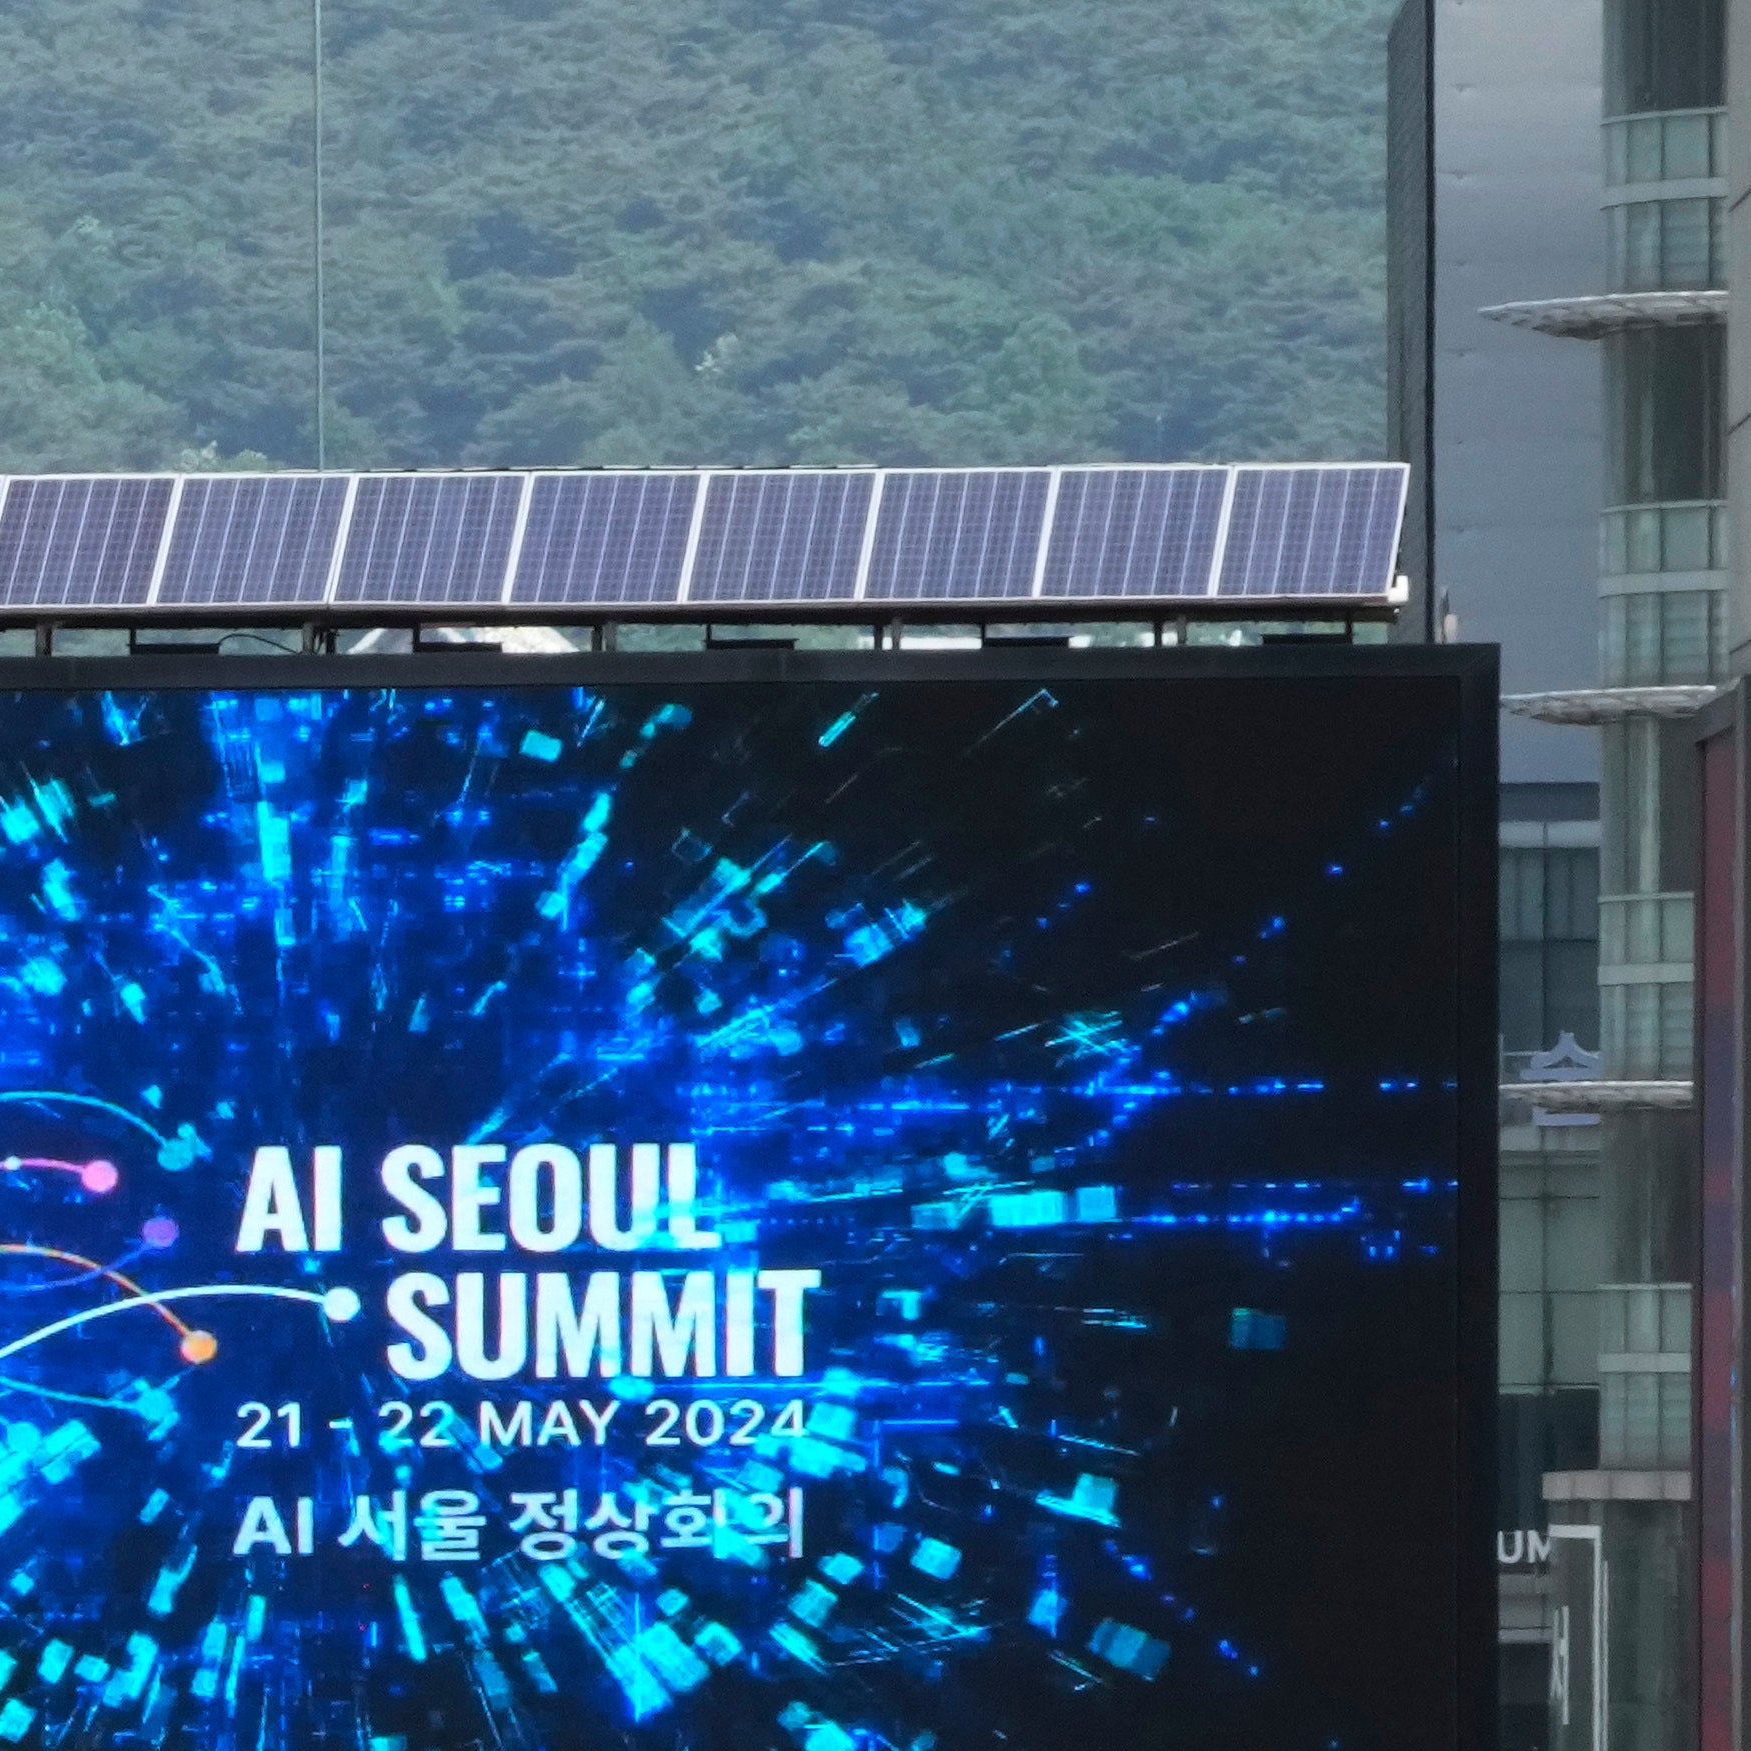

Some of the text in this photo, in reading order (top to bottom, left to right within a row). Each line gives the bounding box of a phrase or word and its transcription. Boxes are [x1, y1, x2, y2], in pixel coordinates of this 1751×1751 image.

[235, 1143, 722, 1253] AI SEOUL
[387, 1269, 821, 1381] SUMMIT
[237, 1402, 301, 1448] 21
[379, 1402, 455, 1448] 22
[478, 1401, 621, 1447] MAY
[645, 1400, 807, 1447] 2024
[233, 1488, 804, 1561] AI 서울 정상회의
